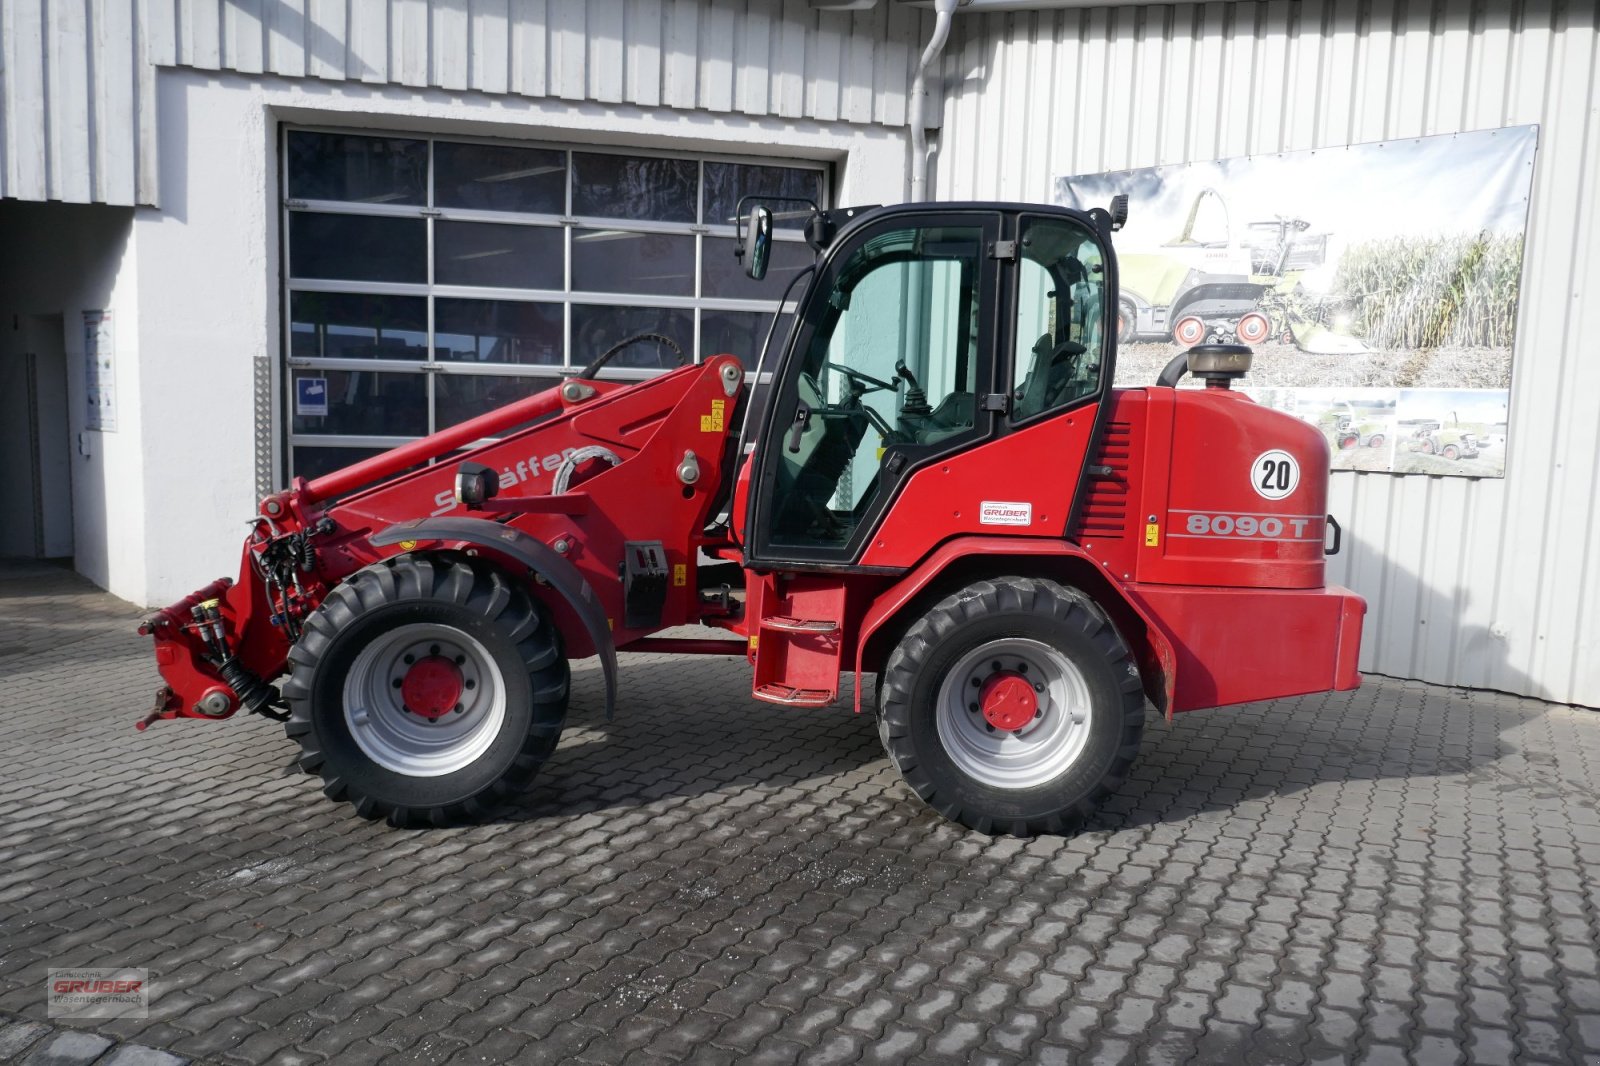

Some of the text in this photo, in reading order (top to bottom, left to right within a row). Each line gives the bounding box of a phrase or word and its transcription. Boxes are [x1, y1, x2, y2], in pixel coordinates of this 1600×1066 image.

[430, 447, 577, 517] Säffer
[1261, 460, 1291, 490] 20
[983, 509, 1028, 517] GRUBER
[1186, 514, 1309, 538] 8090 T
